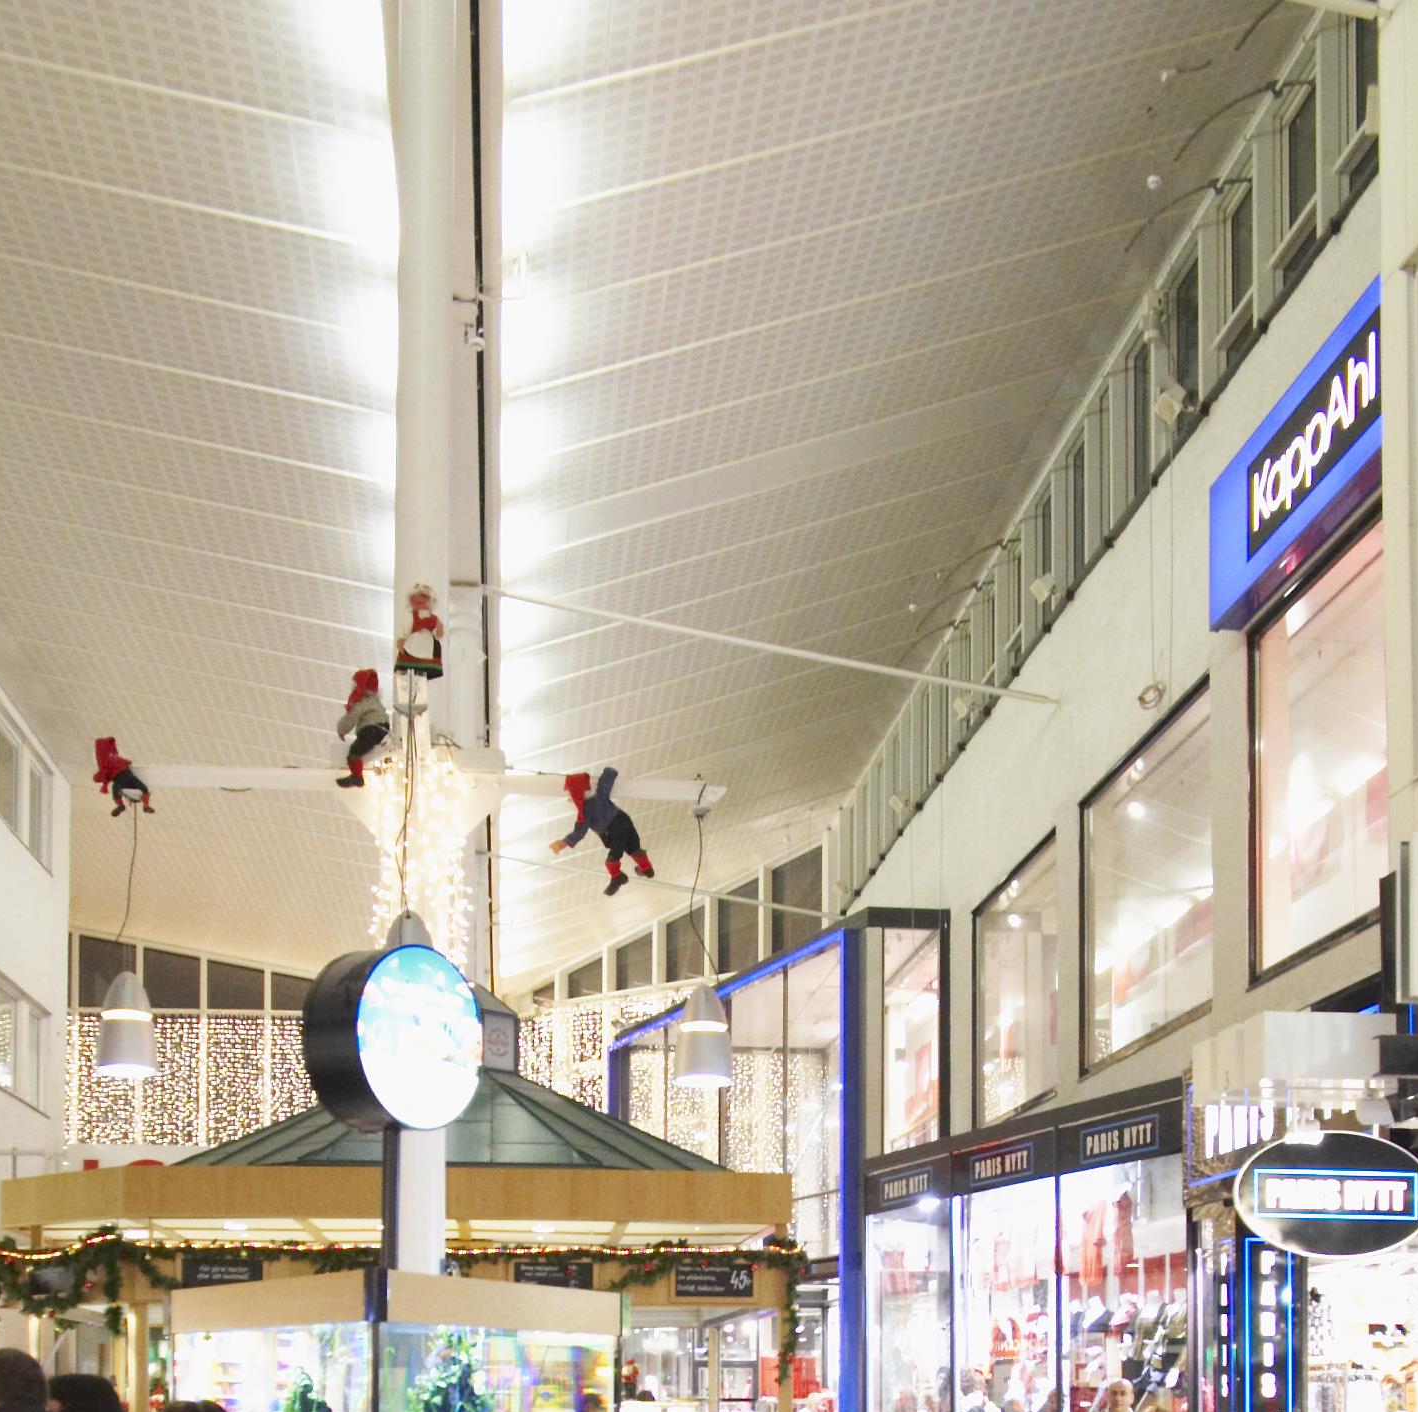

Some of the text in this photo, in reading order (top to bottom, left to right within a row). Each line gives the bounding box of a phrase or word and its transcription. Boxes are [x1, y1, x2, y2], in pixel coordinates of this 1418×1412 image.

[1252, 331, 1377, 532] KappAhl
[1085, 1122, 1153, 1156] PARIS NYTT
[974, 1150, 1029, 1180] PARIS NYTT
[884, 1173, 929, 1200] PARIS NYTT
[1264, 1178, 1408, 1212] PARIS NYTT
[1259, 1250, 1277, 1399] PARIS
